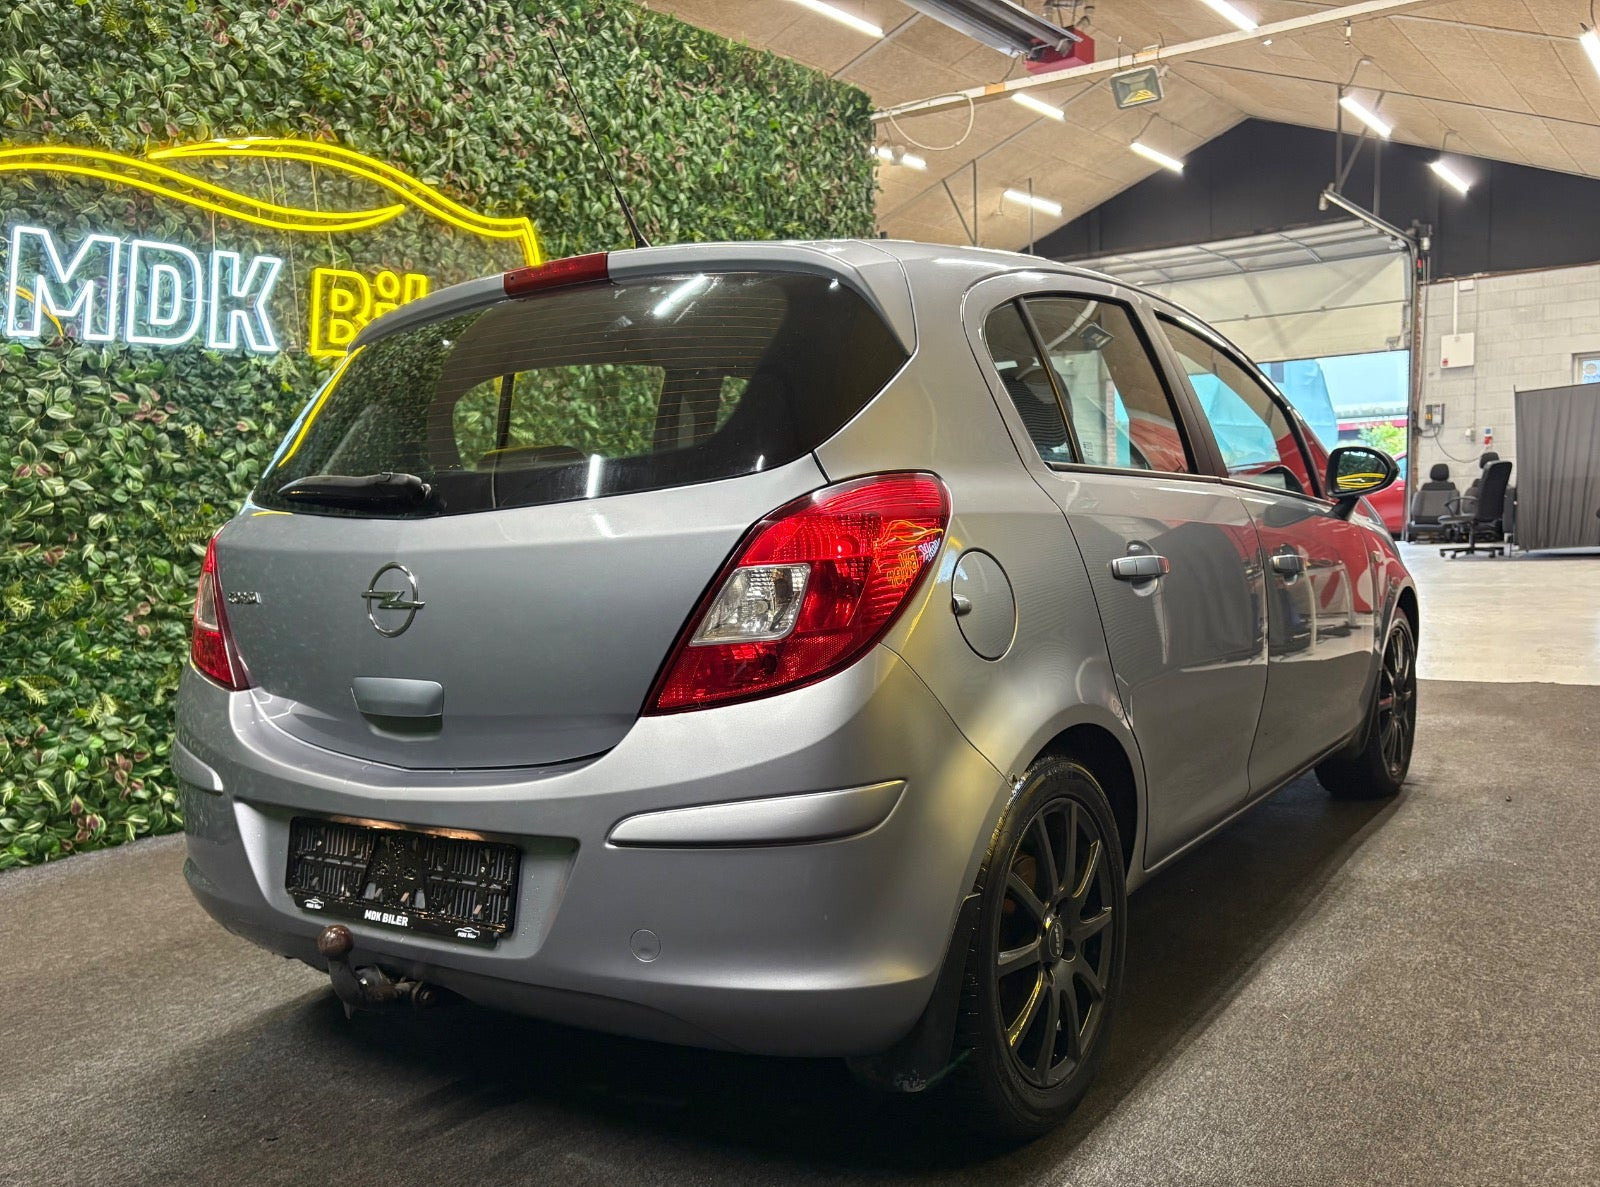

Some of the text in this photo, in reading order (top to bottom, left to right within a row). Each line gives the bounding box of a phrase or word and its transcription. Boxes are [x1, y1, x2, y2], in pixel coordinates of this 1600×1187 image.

[6, 224, 283, 353] MDK
[364, 909, 409, 927] MDK BILER
